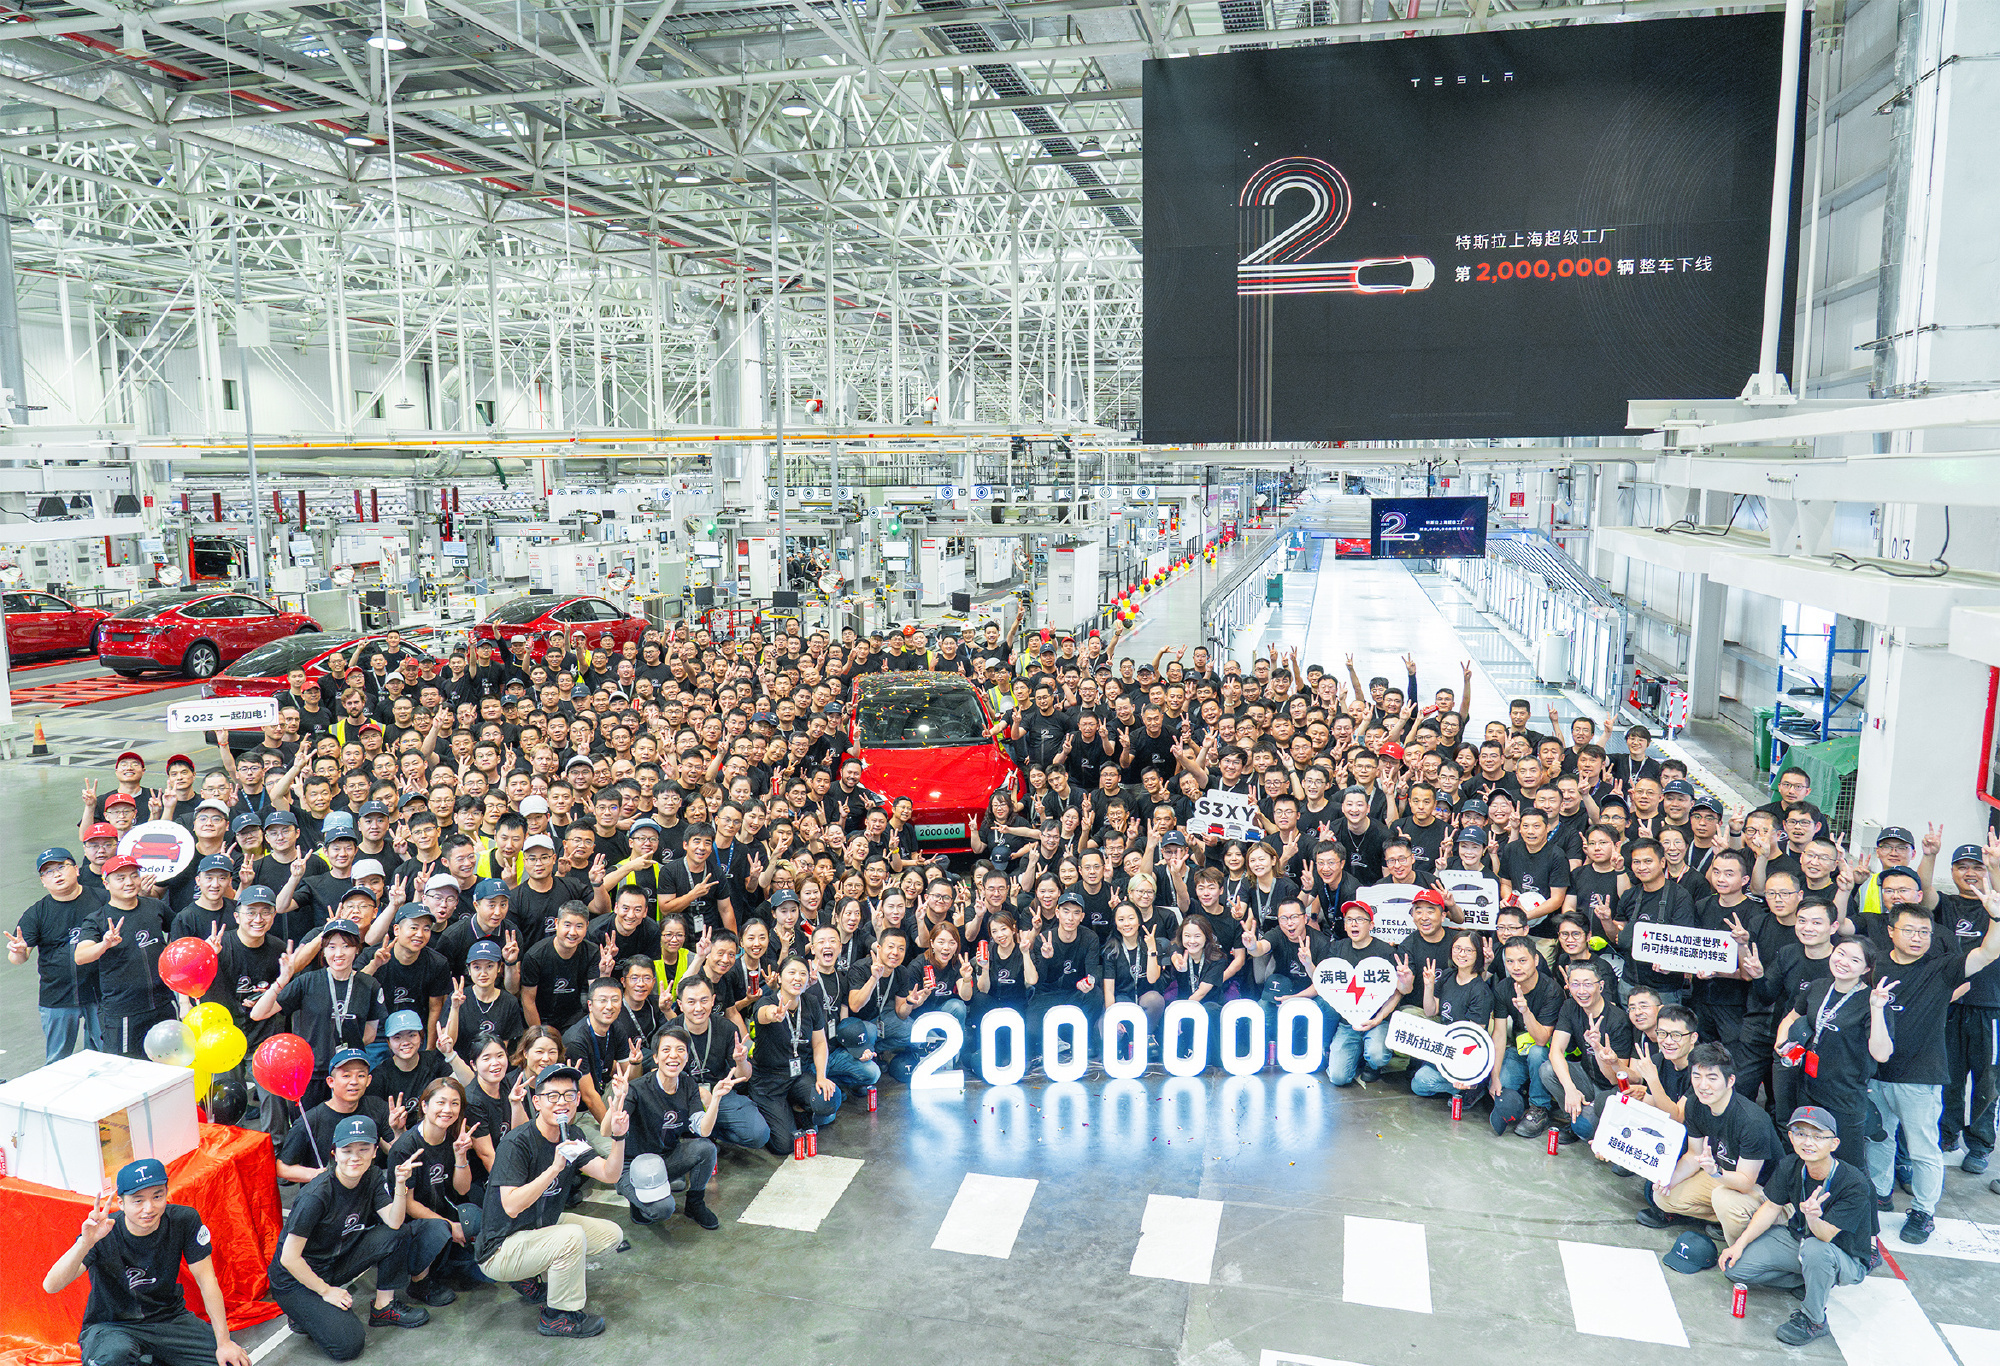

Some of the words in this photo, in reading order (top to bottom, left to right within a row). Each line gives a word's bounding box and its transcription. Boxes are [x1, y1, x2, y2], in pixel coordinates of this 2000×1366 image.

[1411, 72, 1515, 88] TESLA
[1455, 227, 1618, 251] 特斯拉上海超级工厂
[1476, 256, 1612, 285] 2,000,000
[184, 713, 214, 723] 2023
[219, 709, 267, 721] 一起加电!
[1198, 800, 1256, 822] S3XY
[919, 828, 942, 837] 2000
[944, 827, 960, 836] 000
[139, 865, 165, 873] odel
[168, 865, 175, 873] 3
[1463, 908, 1490, 925] 智造
[1648, 931, 1722, 949] TESLA加速世界
[1641, 942, 1728, 963] 向可持续能源的转变
[1319, 970, 1348, 984] 满电
[1363, 969, 1391, 983] 出发
[910, 998, 1324, 1090] 2000000
[1394, 1029, 1457, 1060] 特斯拉速度
[1607, 1136, 1660, 1168] 超级体验之旅
